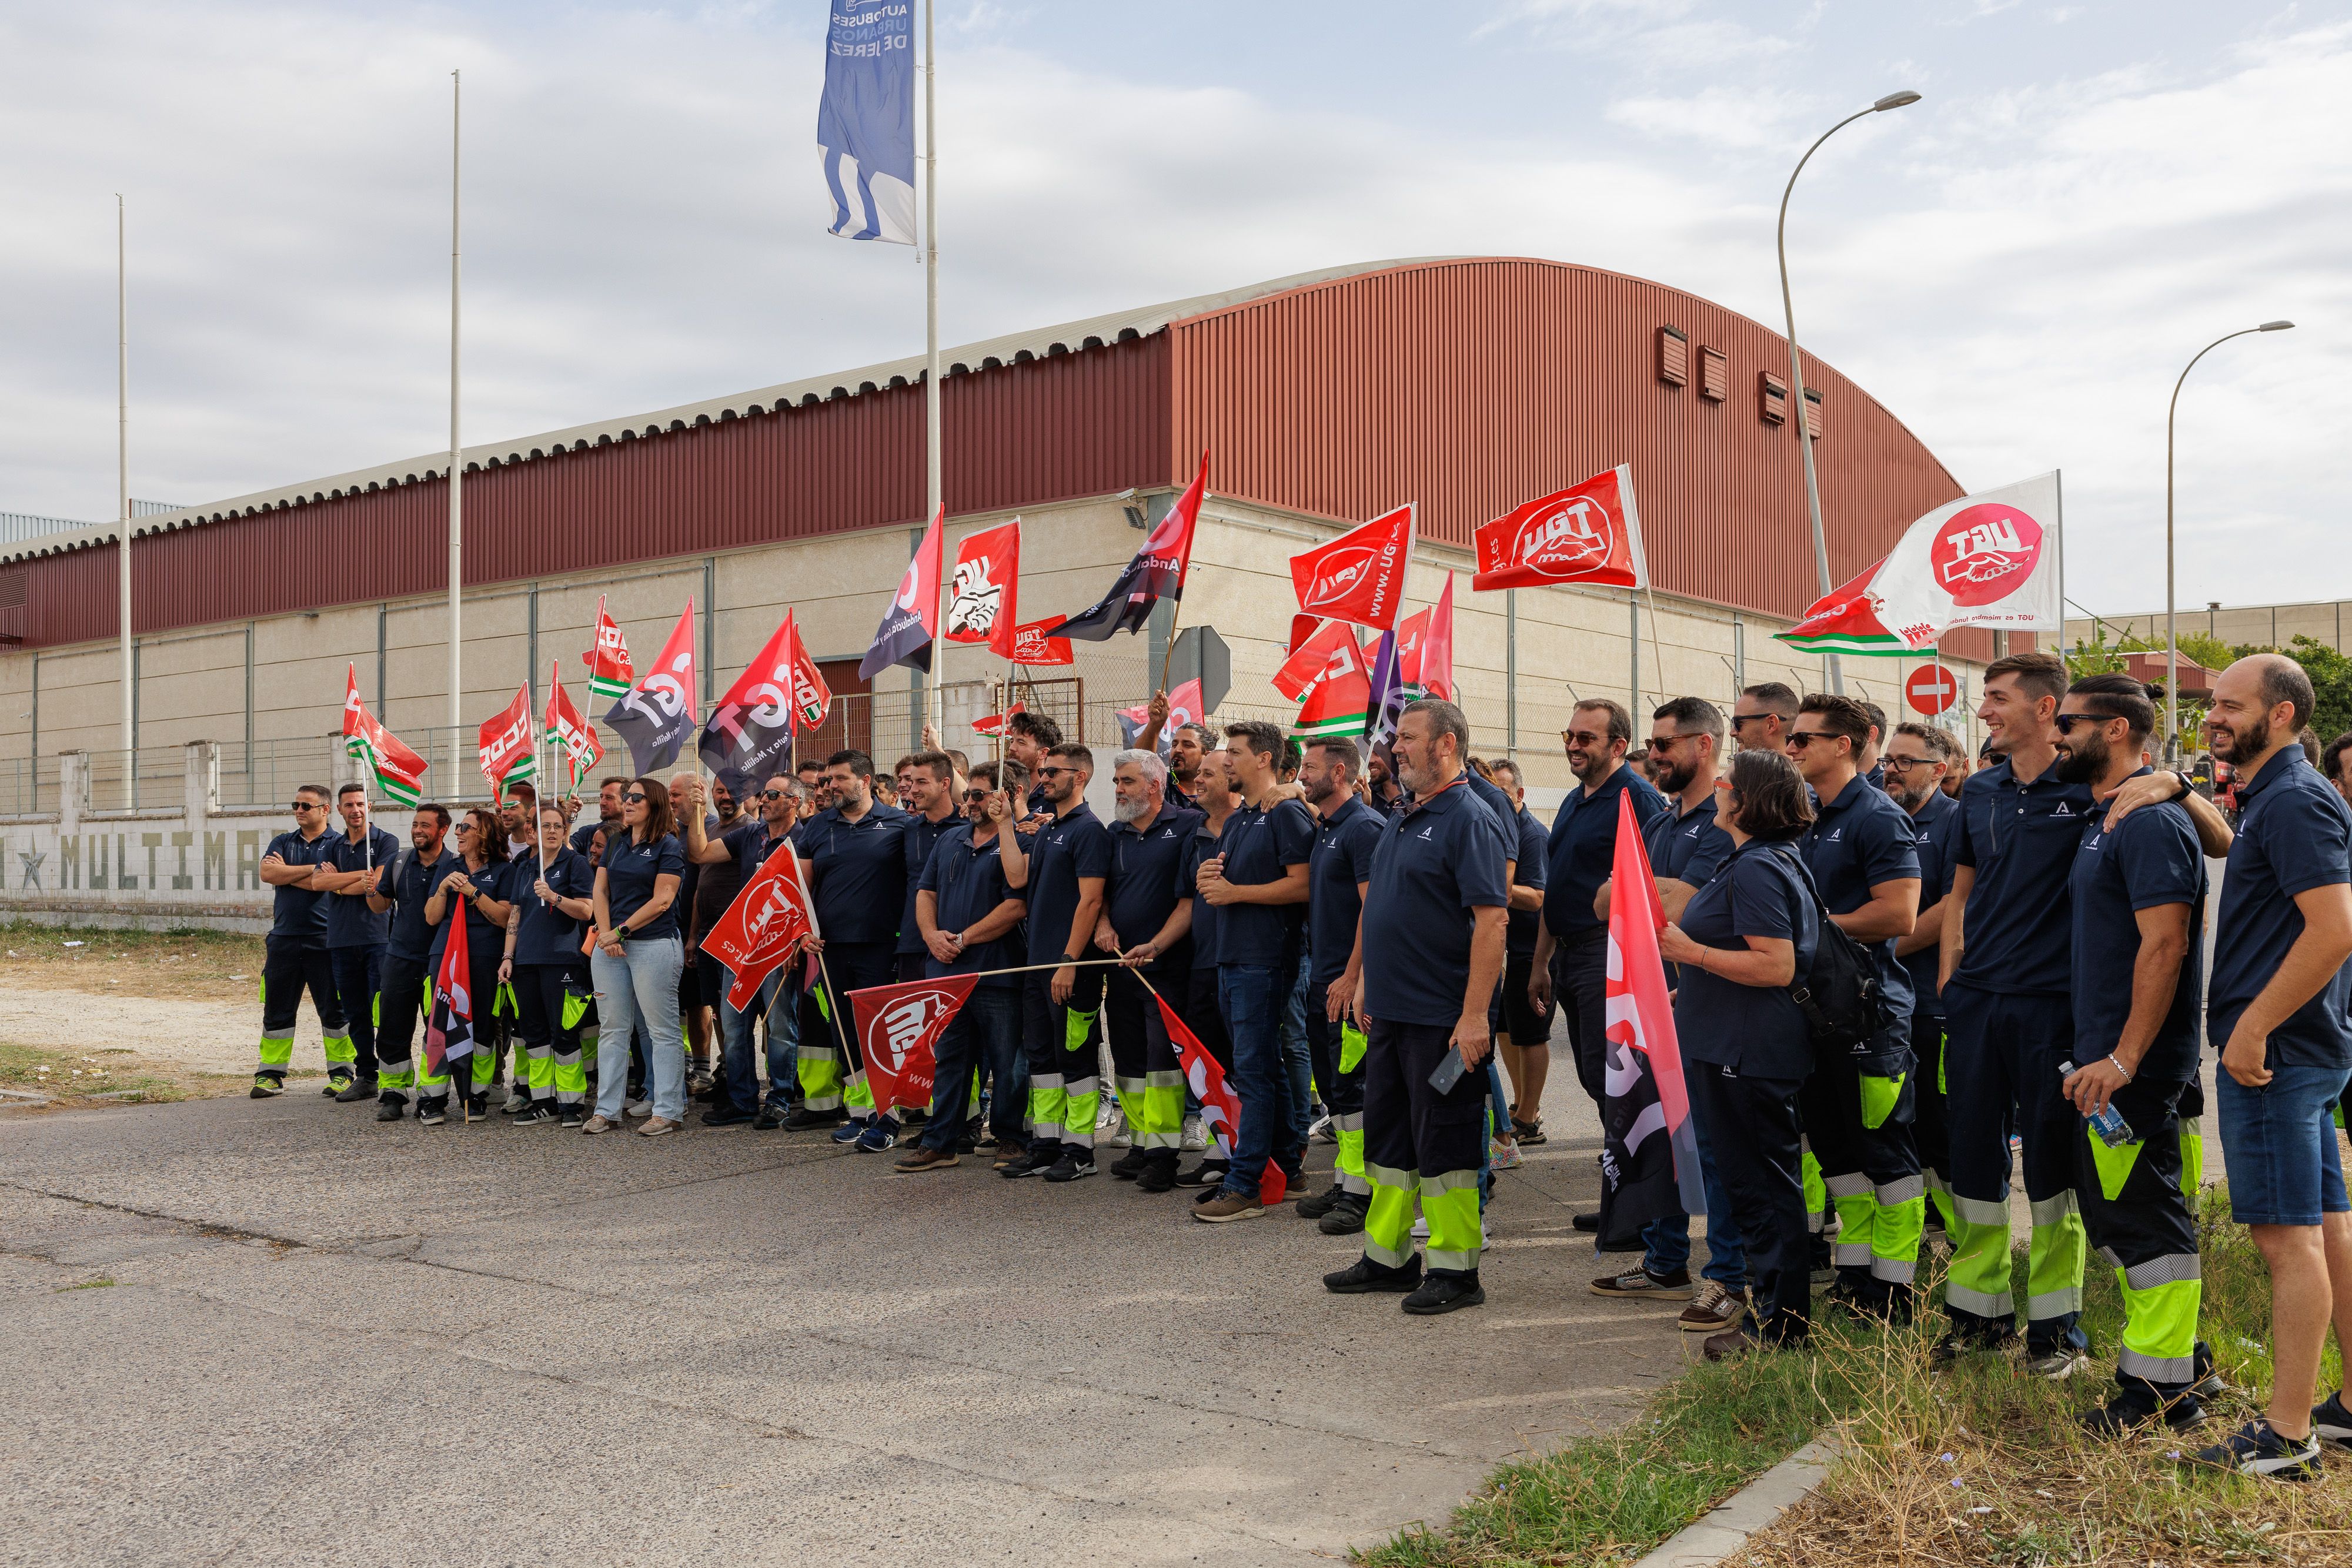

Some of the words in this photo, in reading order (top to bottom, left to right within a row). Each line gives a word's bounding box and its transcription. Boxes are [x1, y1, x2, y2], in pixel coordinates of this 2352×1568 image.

[1522, 501, 1591, 559] UGT
[1015, 628, 1041, 646] UGT
[61, 830, 259, 890] MULTIMA
